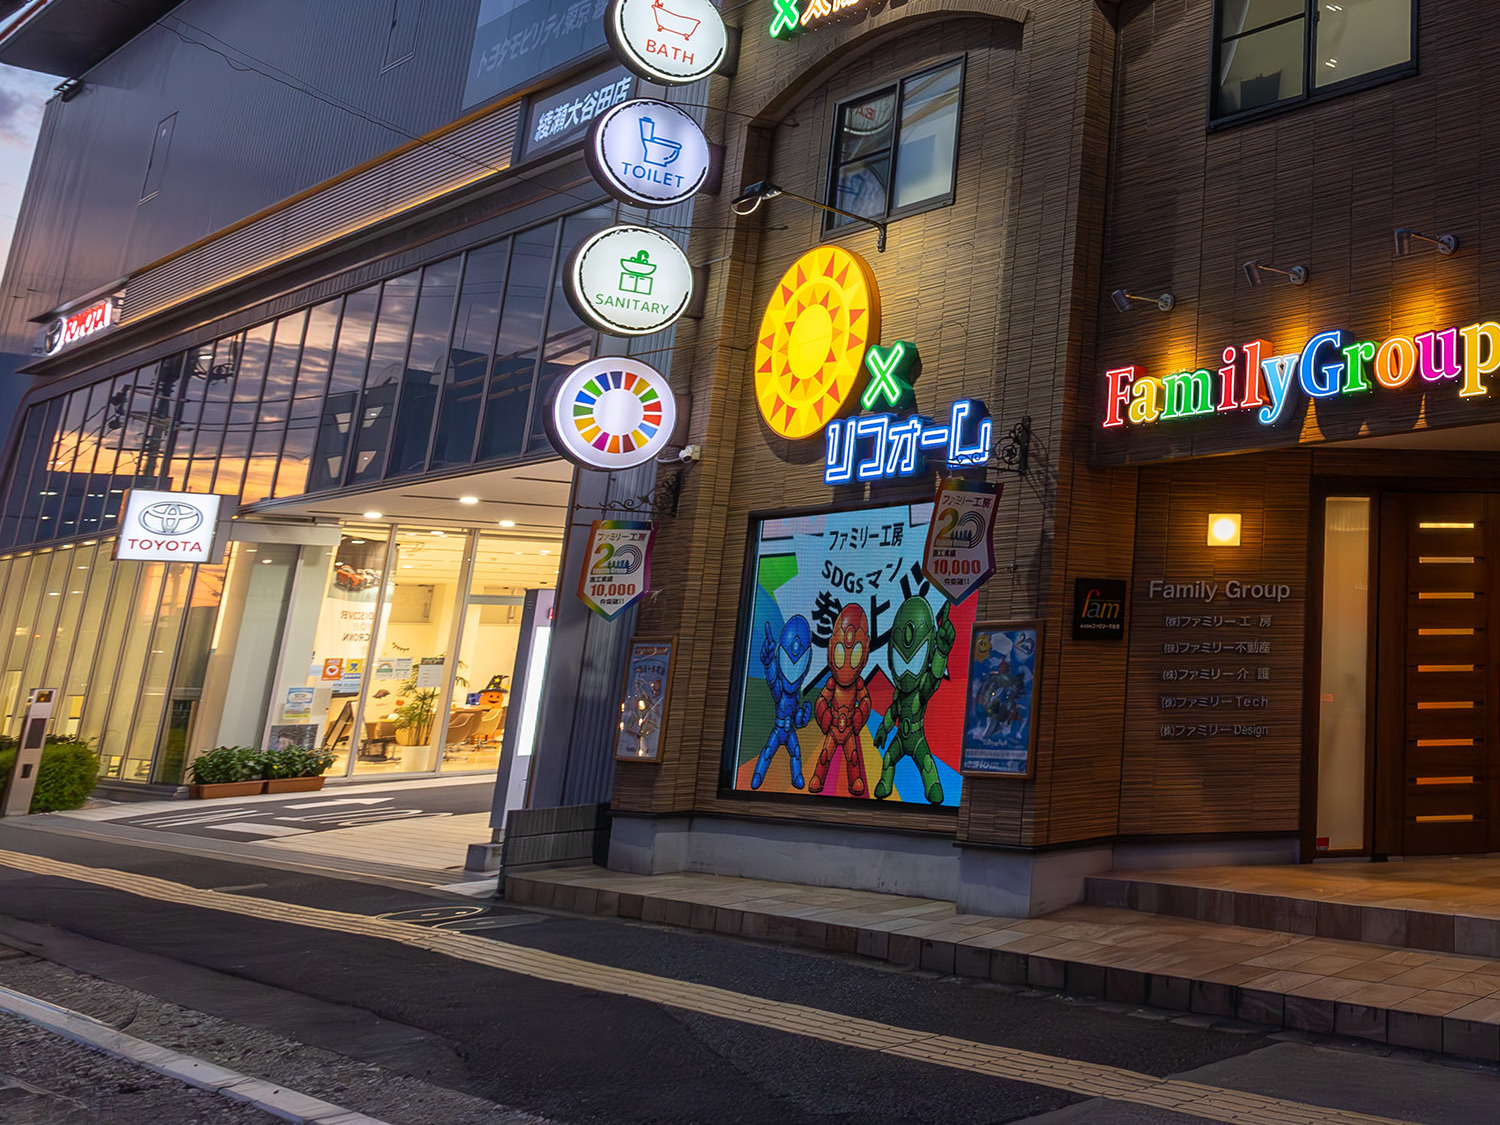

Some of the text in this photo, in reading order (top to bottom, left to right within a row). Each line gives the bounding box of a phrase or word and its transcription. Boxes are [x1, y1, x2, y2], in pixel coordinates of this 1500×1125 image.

[645, 38, 695, 66] BATH
[534, 75, 633, 142] 綾瀬大谷田店
[621, 160, 686, 190] TOILET
[594, 292, 670, 317] SANITARY
[824, 397, 993, 486] リフォーム
[942, 494, 993, 509] ファミリー工房
[127, 537, 202, 553] TOYOTA
[597, 532, 647, 542] ファミリー工房
[829, 522, 905, 551] ファミリー工房
[821, 556, 904, 594] SDGsマン
[933, 559, 981, 577] 10,000
[590, 583, 636, 597] 10,000
[1148, 579, 1291, 603] Family Group
